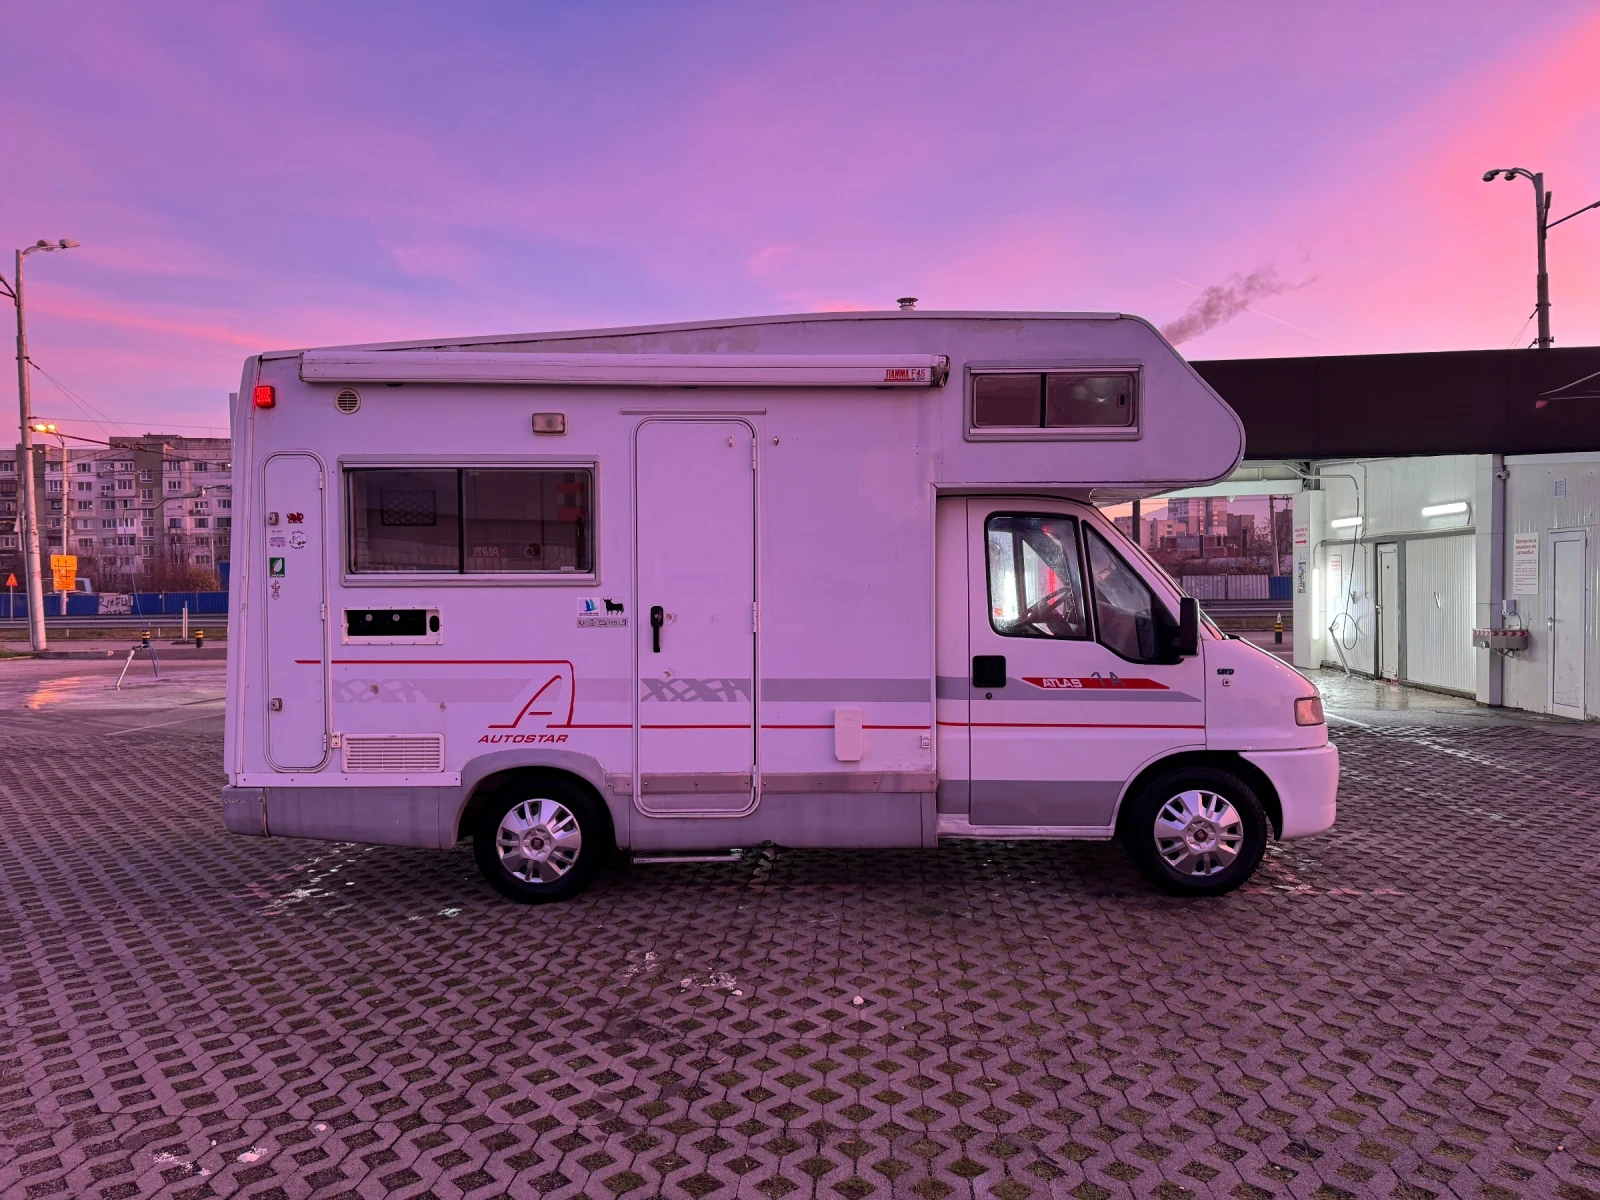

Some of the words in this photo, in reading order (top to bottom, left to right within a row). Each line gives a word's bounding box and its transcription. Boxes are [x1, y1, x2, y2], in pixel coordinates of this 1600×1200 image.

[886, 369, 909, 378] FIAMMA
[911, 369, 926, 377] F45
[1042, 678, 1083, 688] ATLAS
[477, 734, 569, 744] AUTOSTAR
